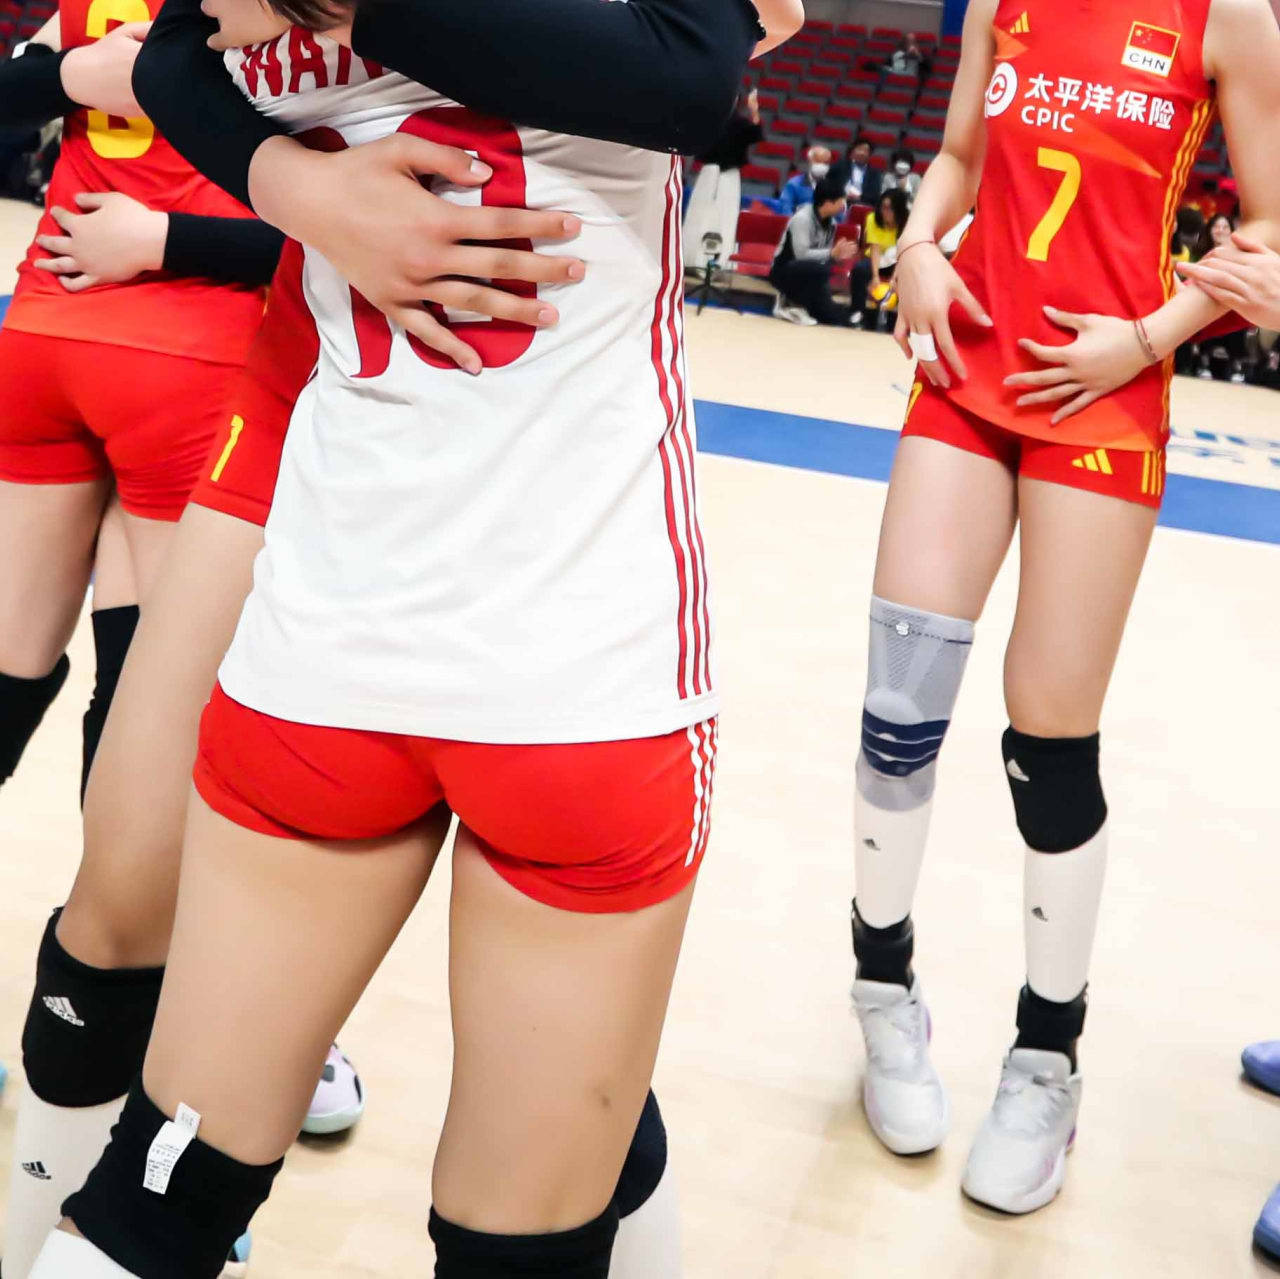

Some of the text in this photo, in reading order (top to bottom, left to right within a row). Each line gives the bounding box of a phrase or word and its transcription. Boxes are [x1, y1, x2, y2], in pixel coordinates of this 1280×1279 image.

[1128, 52, 1166, 72] CHN
[1020, 104, 1076, 133] CPIC
[1023, 72, 1176, 131] 太平洋保险
[1025, 145, 1082, 262] 7
